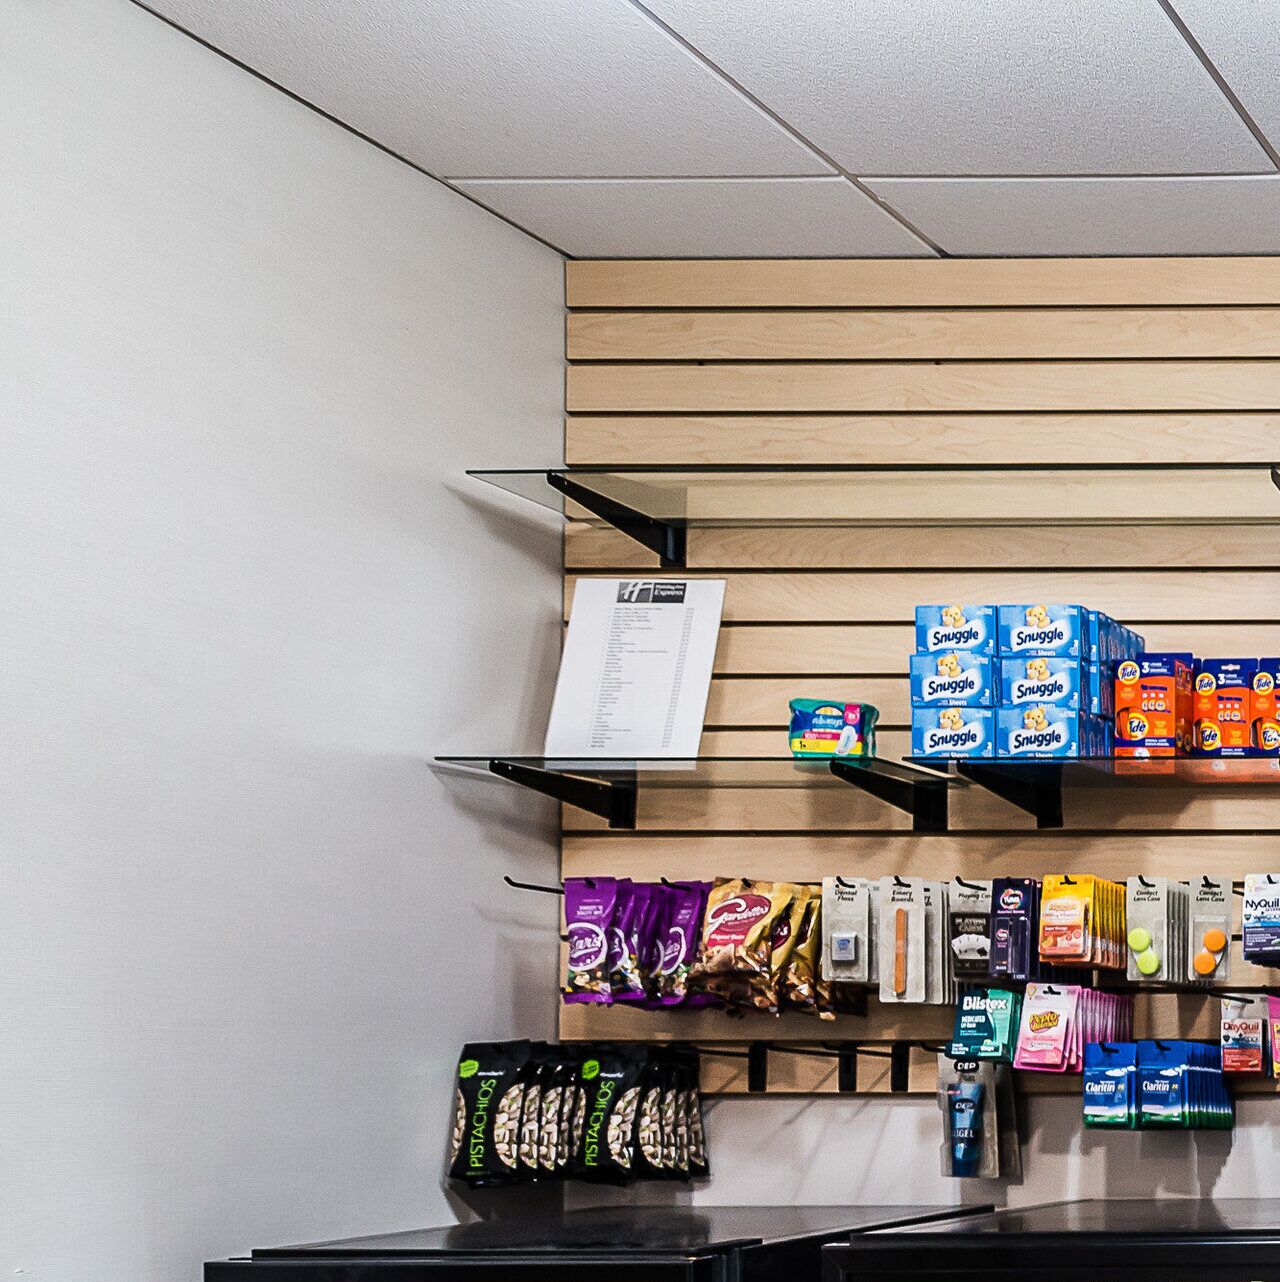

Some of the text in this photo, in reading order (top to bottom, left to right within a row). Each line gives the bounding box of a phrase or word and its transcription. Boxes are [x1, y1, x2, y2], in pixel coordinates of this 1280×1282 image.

[933, 627, 979, 646] Snuggle
[1016, 627, 1063, 646] Snuggle
[1120, 664, 1138, 680] Tide
[928, 677, 974, 696] Snuggle
[1017, 679, 1063, 699] Snuggle
[1197, 677, 1215, 691] Tide
[1255, 676, 1273, 691] Tide
[929, 730, 977, 749] Snuggle
[1014, 730, 1061, 749] Snuggle
[892, 890, 912, 898] Emery
[958, 892, 980, 901] Playing
[1136, 890, 1159, 898] Contact
[1245, 898, 1280, 911] NyQuil
[962, 996, 1008, 1012] Blistex
[1030, 1011, 1060, 1023] Pepto
[1223, 1021, 1259, 1033] DayQuil
[957, 1062, 977, 1070] DEP
[1085, 1081, 1116, 1094] Claritin
[1142, 1081, 1170, 1093] Claritin
[470, 1079, 497, 1168] PISTACHIOS
[584, 1080, 616, 1167] PISTACHIOS
